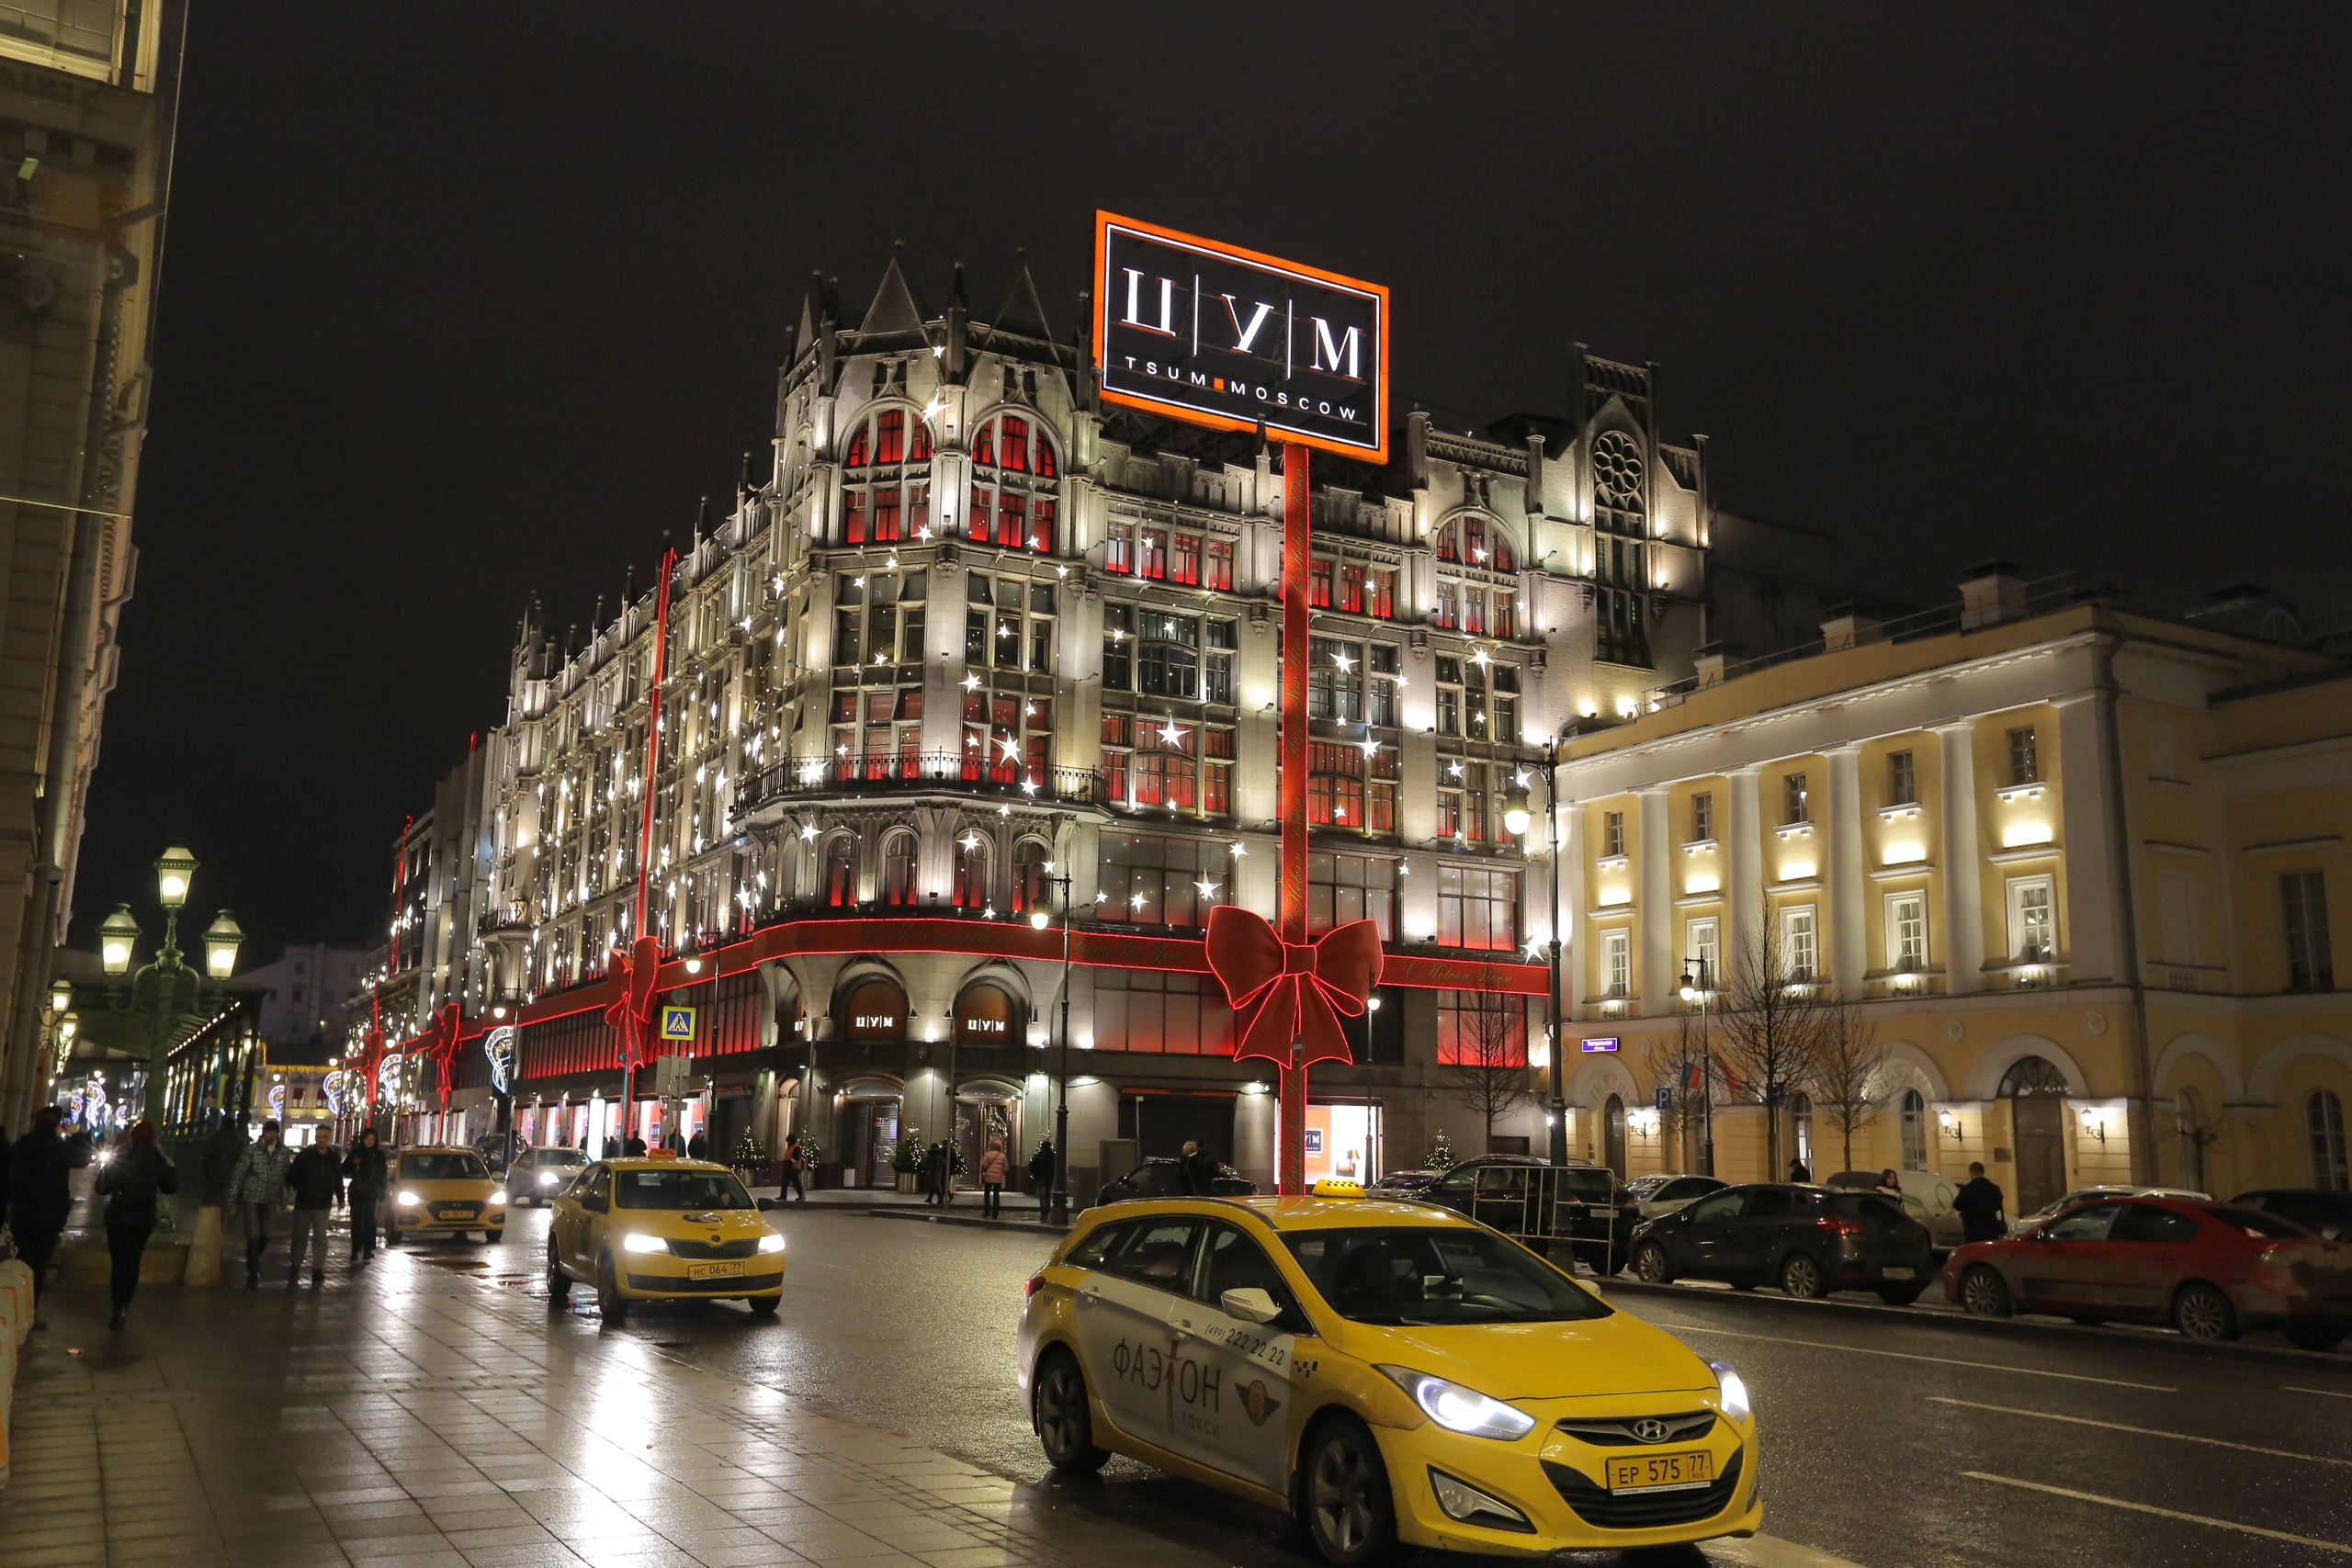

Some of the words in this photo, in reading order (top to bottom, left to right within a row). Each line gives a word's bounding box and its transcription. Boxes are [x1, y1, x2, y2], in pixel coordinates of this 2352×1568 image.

[1125, 356, 1206, 386] TSUM
[1231, 379, 1356, 422] MOSCOW
[1288, 467, 1305, 514] Годом
[1289, 518, 1306, 577] Новым
[1287, 852, 1303, 915] Новым
[1419, 962, 1470, 982] Новым
[709, 1265, 727, 1275] 064
[1204, 1324, 1227, 1341] (499)
[1226, 1328, 1250, 1349] 222
[1250, 1339, 1266, 1358] 22
[1269, 1347, 1285, 1366] 22
[1648, 1459, 1680, 1482] 575
[1689, 1454, 1705, 1472] 77
[1692, 1472, 1704, 1480] RUS
